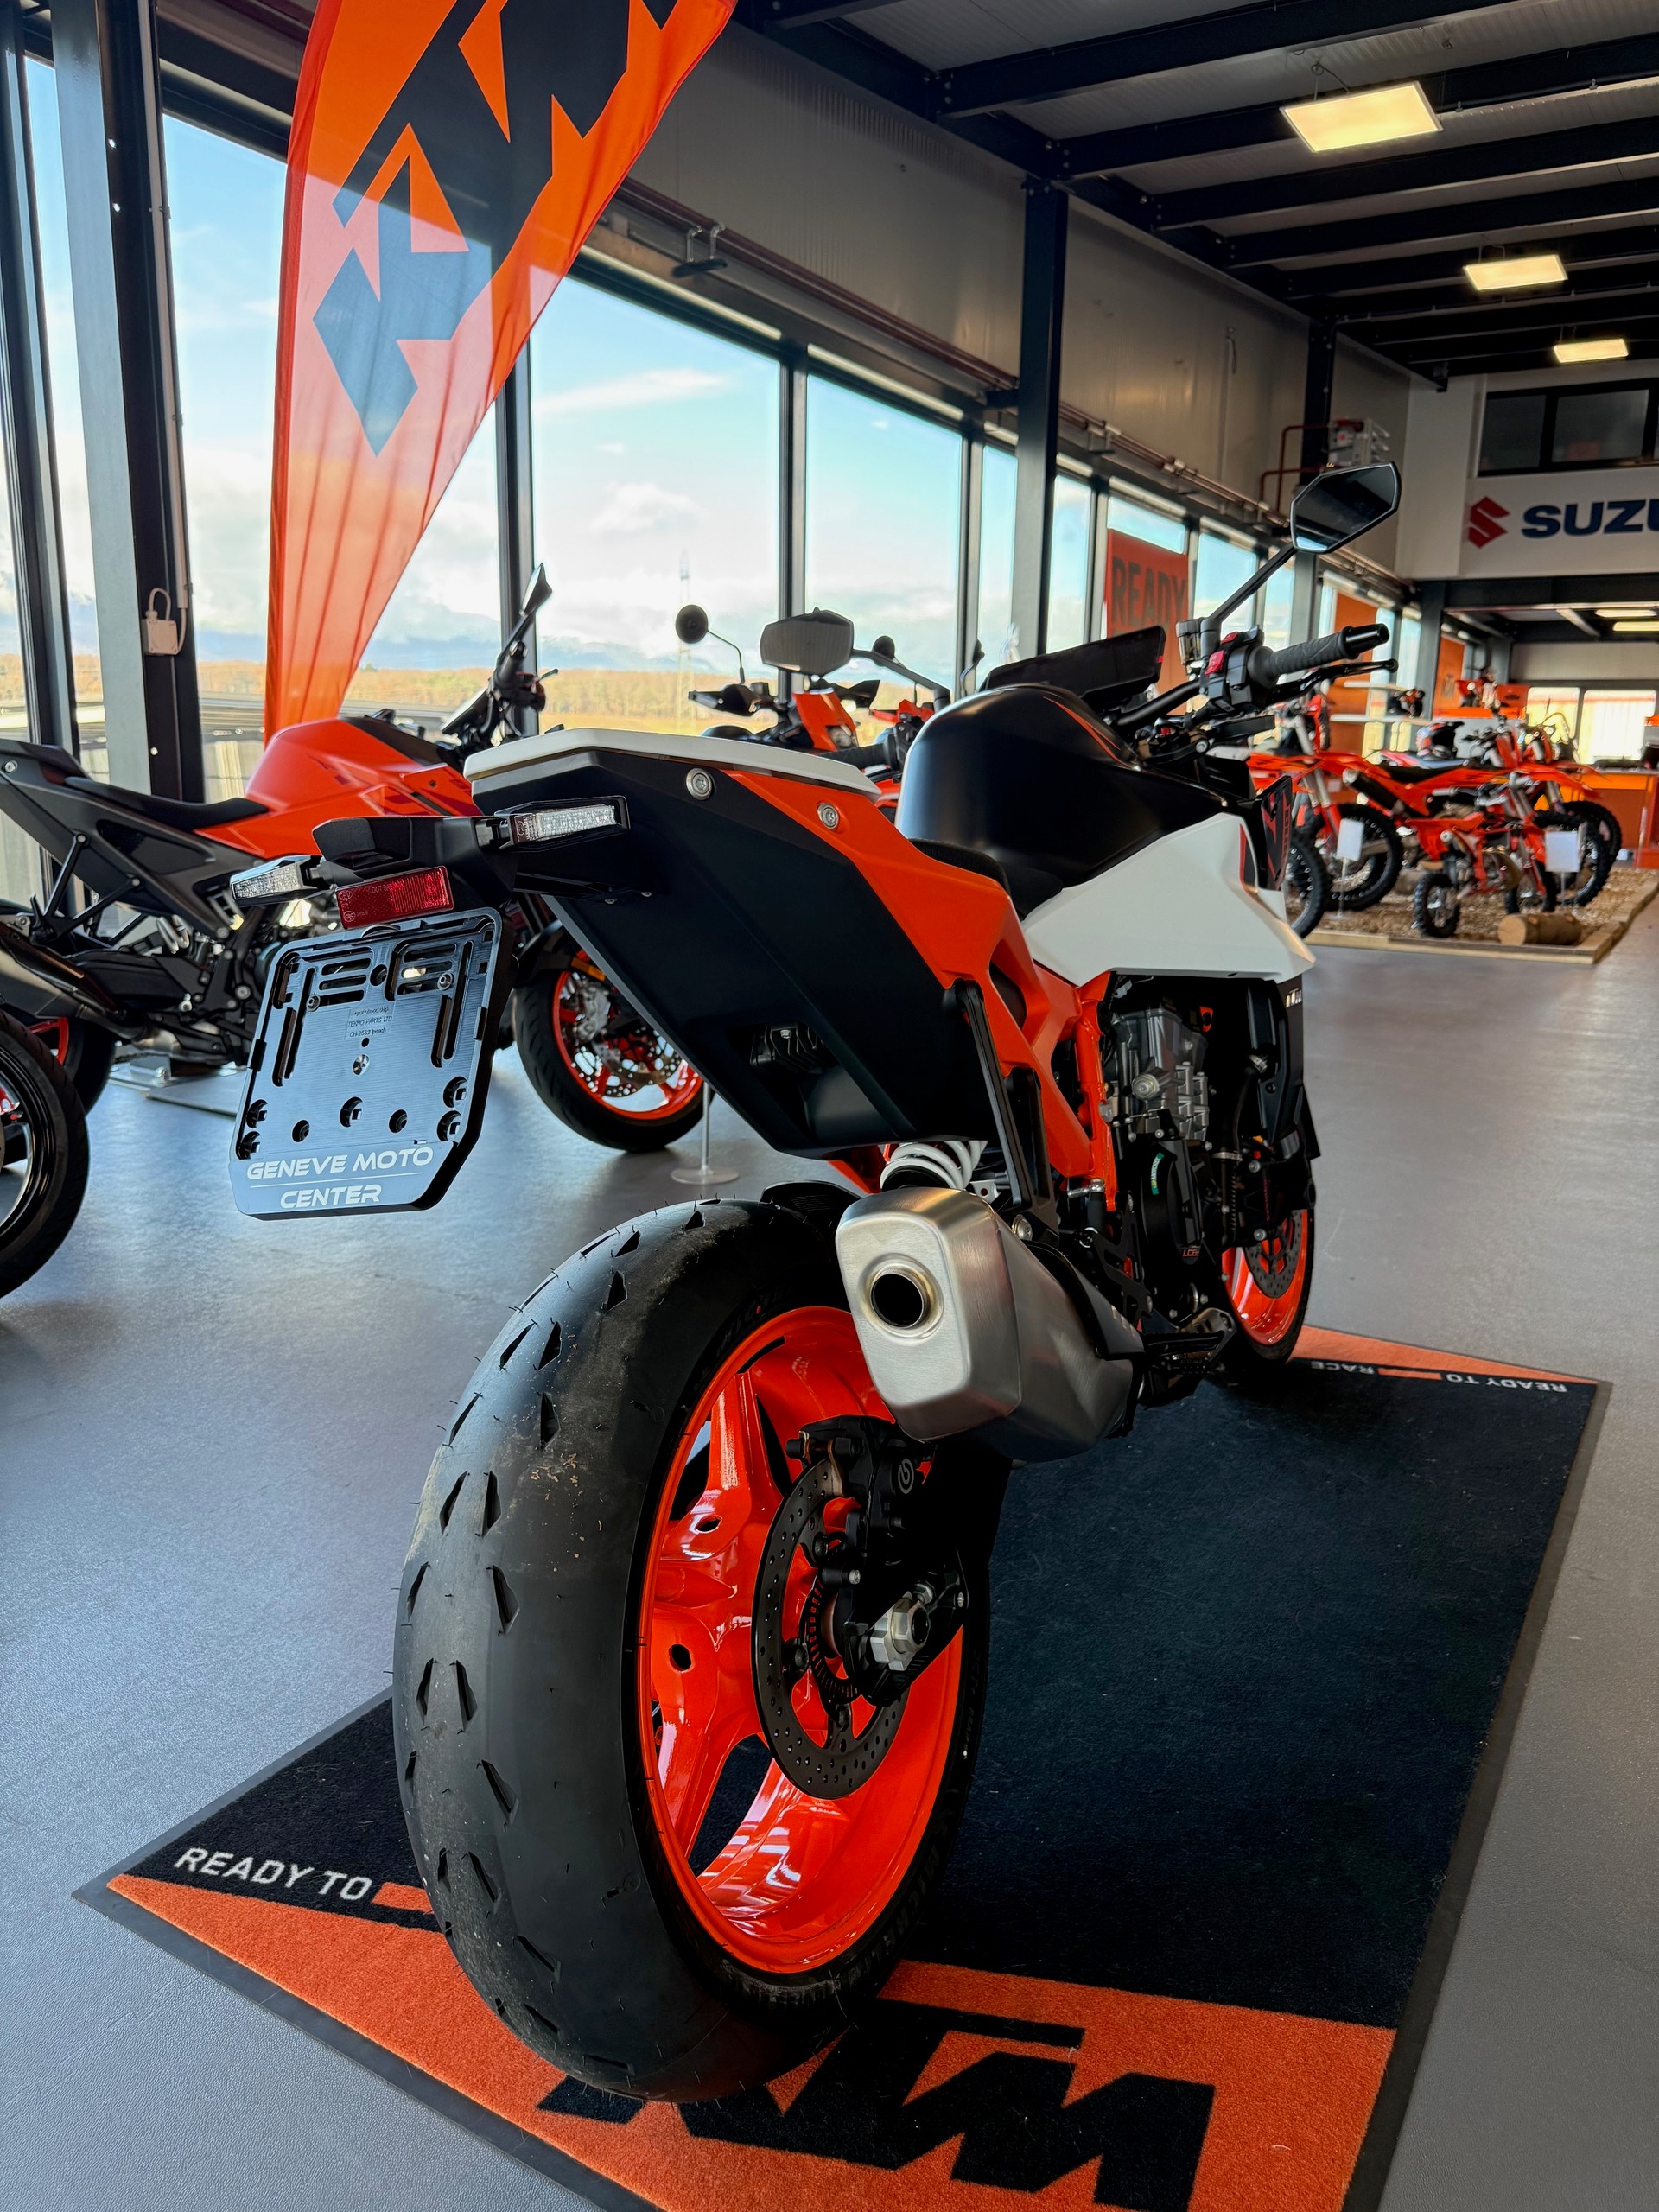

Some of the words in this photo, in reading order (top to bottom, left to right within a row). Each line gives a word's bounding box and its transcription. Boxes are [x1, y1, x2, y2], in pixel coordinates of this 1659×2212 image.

[1522, 499, 1659, 539] SUZ
[1112, 556, 1187, 628] READY
[246, 1154, 348, 1180] GENEVE
[352, 1146, 434, 1172] MOTO
[280, 1184, 382, 1209] CENTER
[1311, 1360, 1375, 1376] RACE
[1446, 1373, 1479, 1384] TO
[1486, 1378, 1568, 1393] READY
[174, 1847, 313, 1889] READY
[318, 1870, 372, 1901] TO
